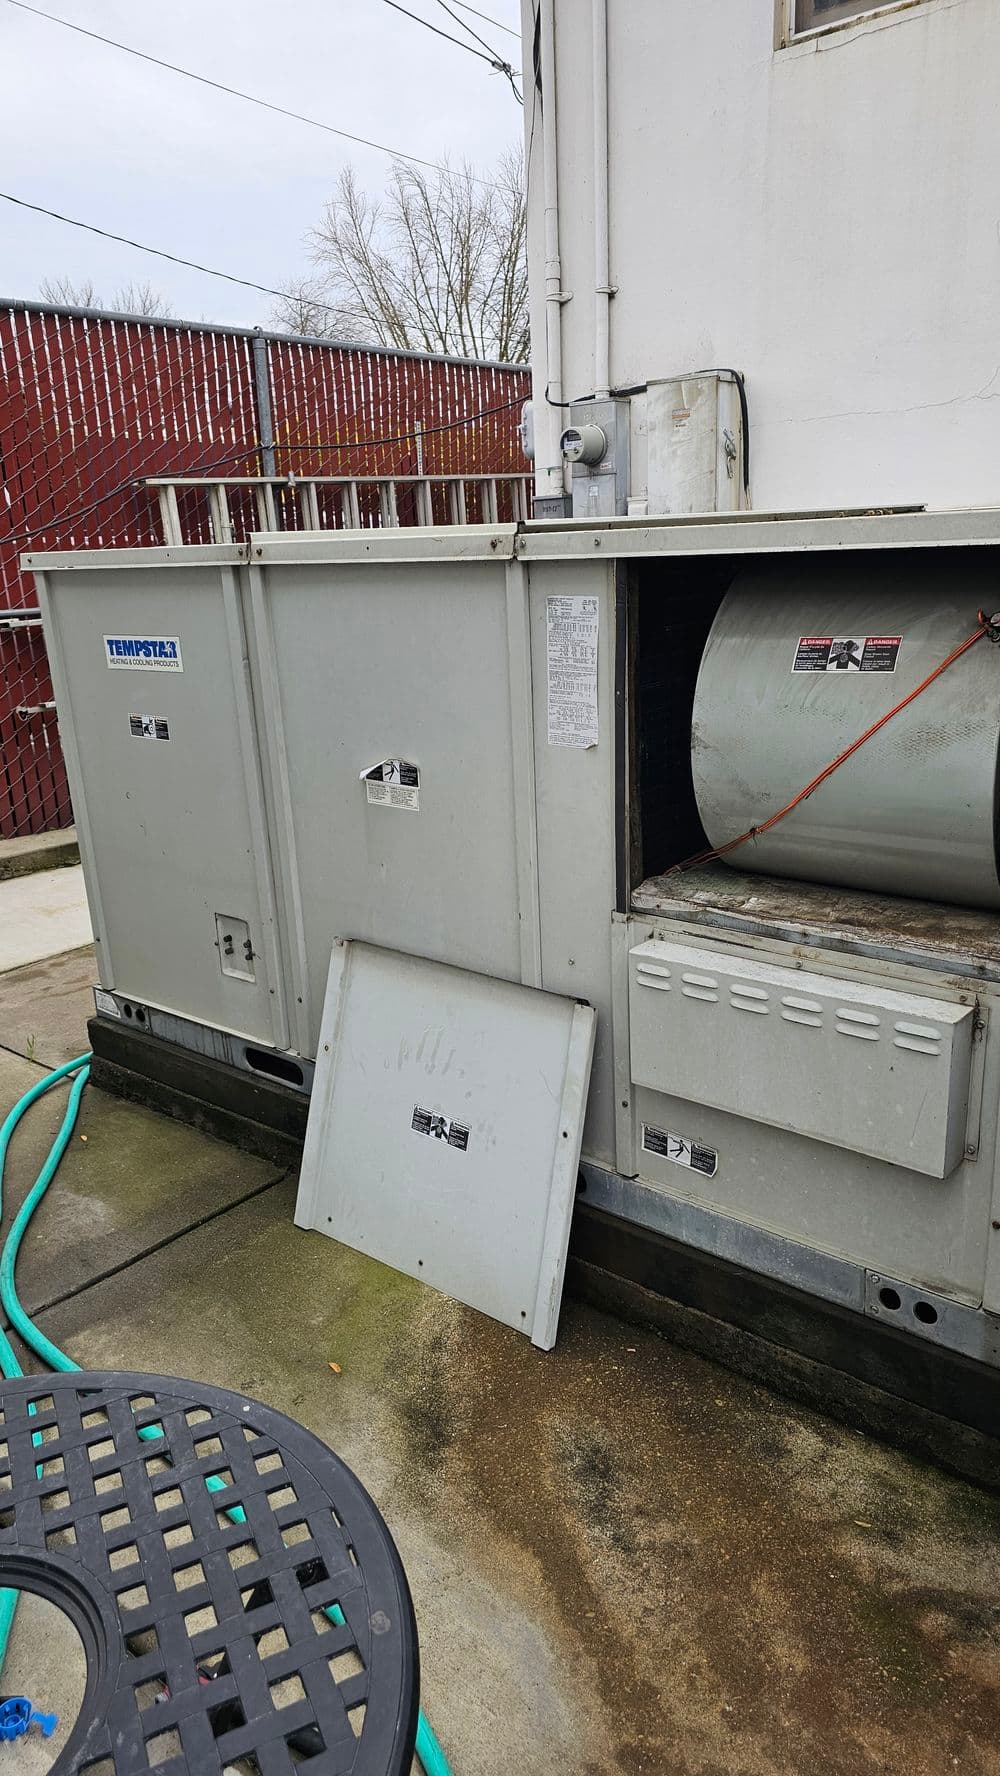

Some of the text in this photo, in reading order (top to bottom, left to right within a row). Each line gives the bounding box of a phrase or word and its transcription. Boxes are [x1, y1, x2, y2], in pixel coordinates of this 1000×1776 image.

[106, 639, 178, 658] TEMPSTAR
[132, 658, 153, 666] COOLING
[154, 659, 180, 667] PRODUCTS
